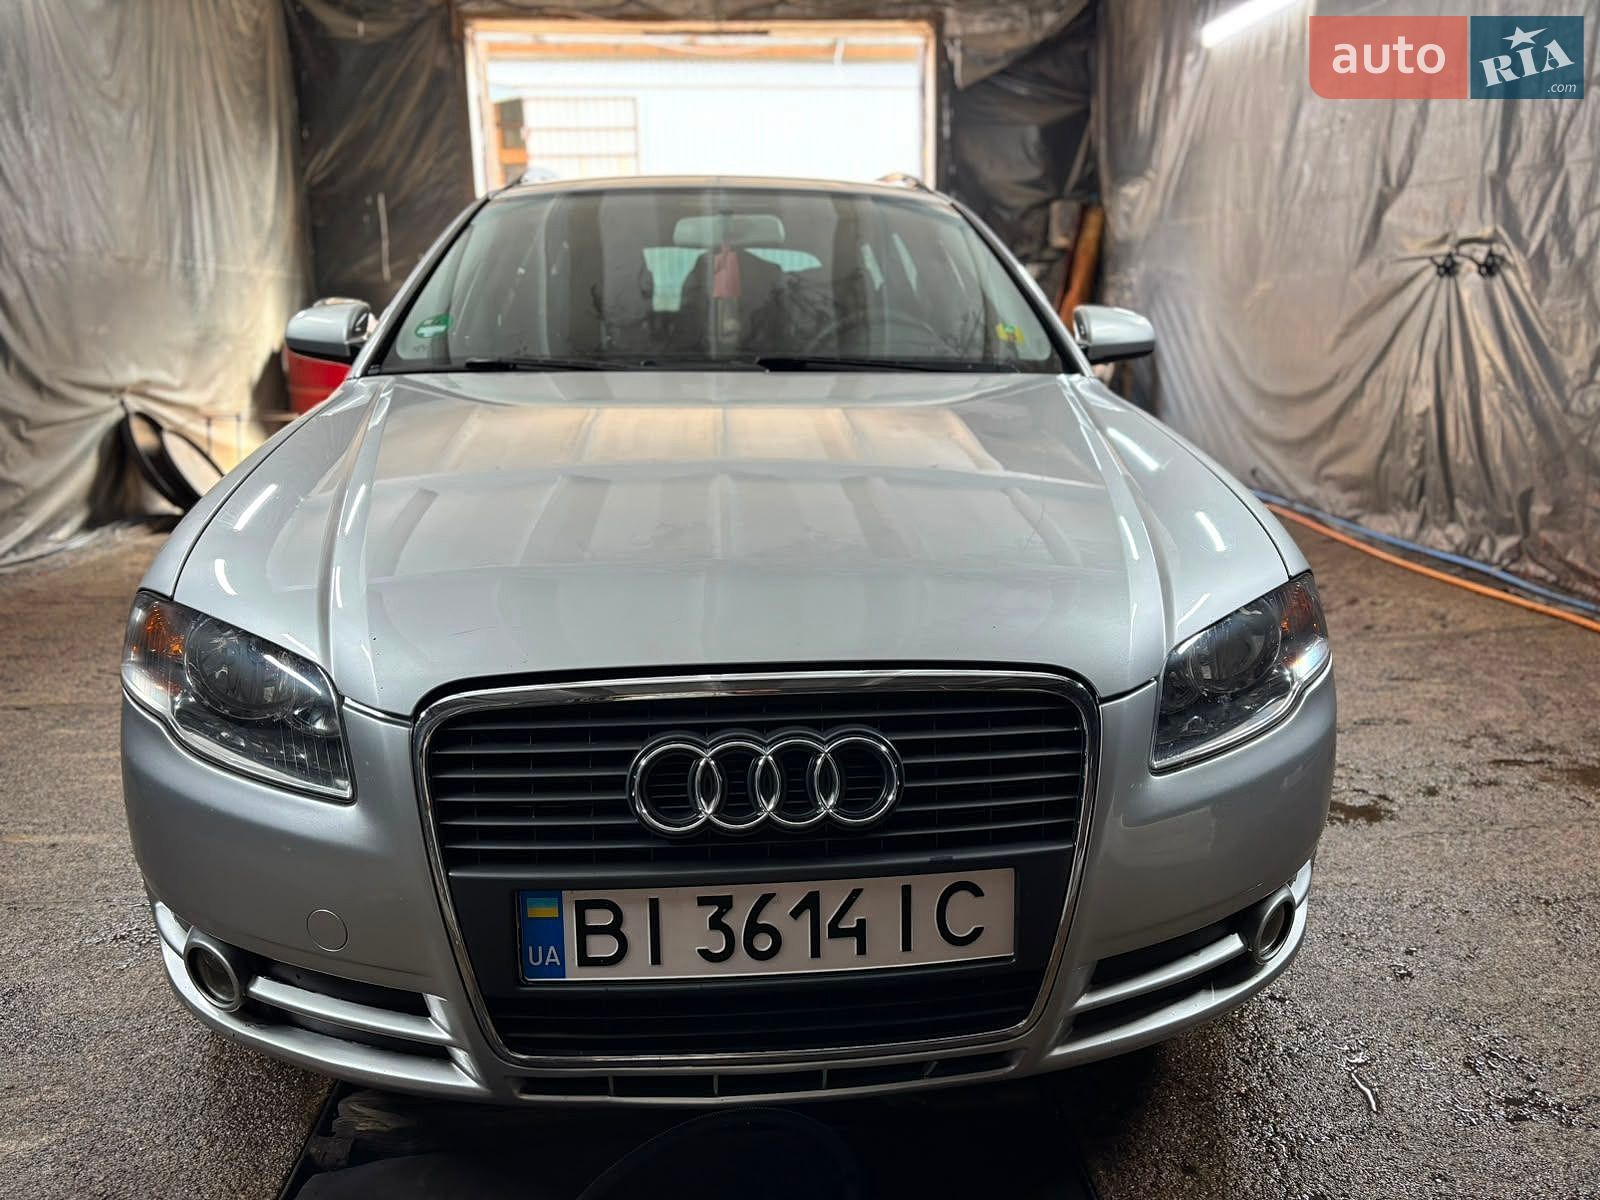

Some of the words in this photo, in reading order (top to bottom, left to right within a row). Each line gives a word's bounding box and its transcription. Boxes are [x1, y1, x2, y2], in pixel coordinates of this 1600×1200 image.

[574, 896, 662, 967] BI
[696, 887, 868, 963] 3614
[899, 880, 986, 953] IC
[528, 946, 561, 966] UA
